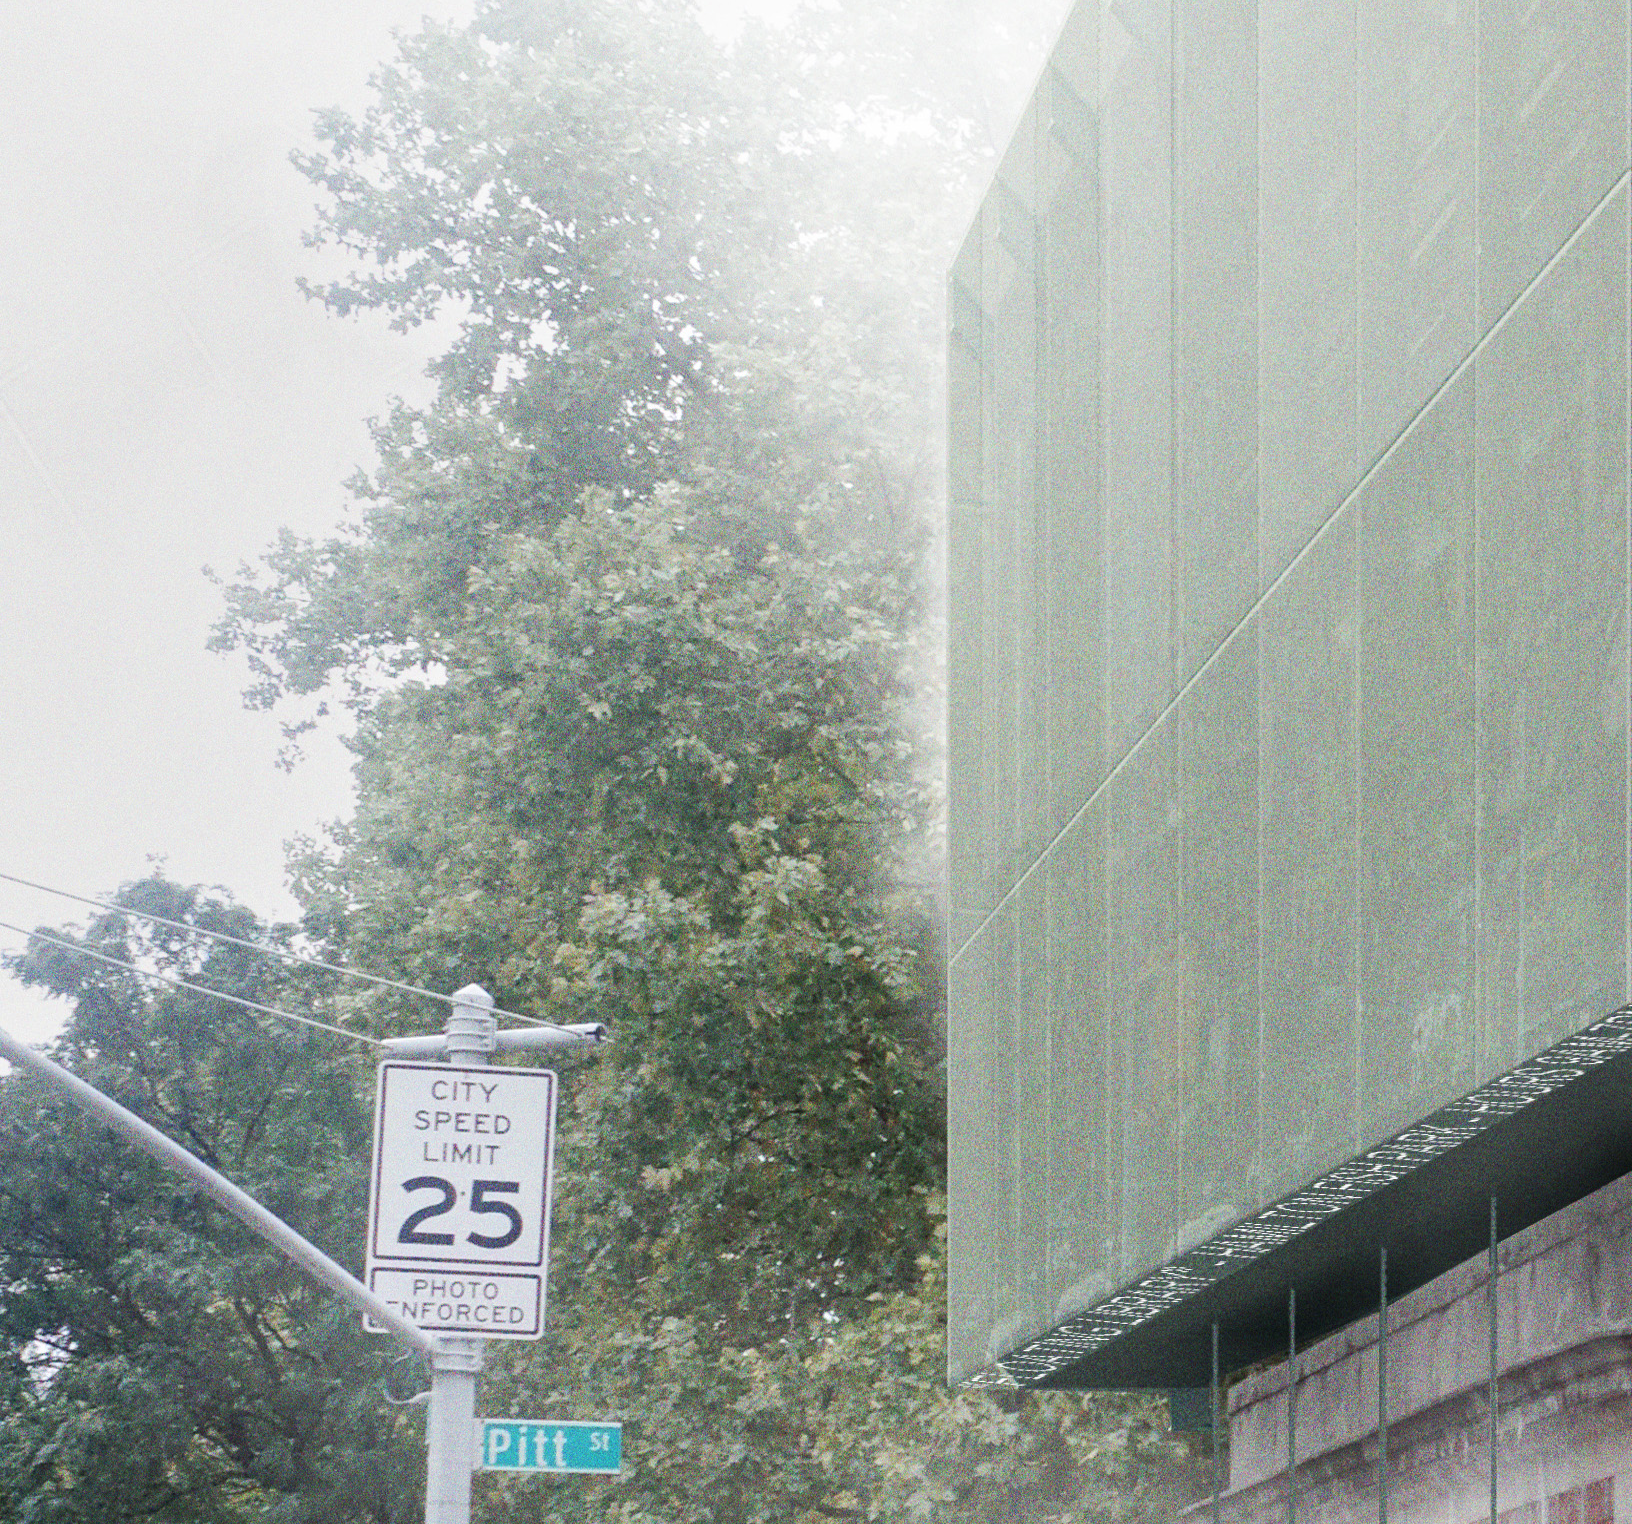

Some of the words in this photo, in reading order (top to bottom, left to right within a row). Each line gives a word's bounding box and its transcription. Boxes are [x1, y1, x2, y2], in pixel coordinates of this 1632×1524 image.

[430, 1079, 499, 1104] CITY
[414, 1109, 512, 1136] SPEED
[423, 1141, 501, 1165] LIMIT
[397, 1175, 524, 1249] 25
[412, 1278, 500, 1301] PHOTO
[387, 1300, 525, 1325] NFORCED
[488, 1426, 568, 1467] Pitt
[589, 1431, 611, 1452] St
